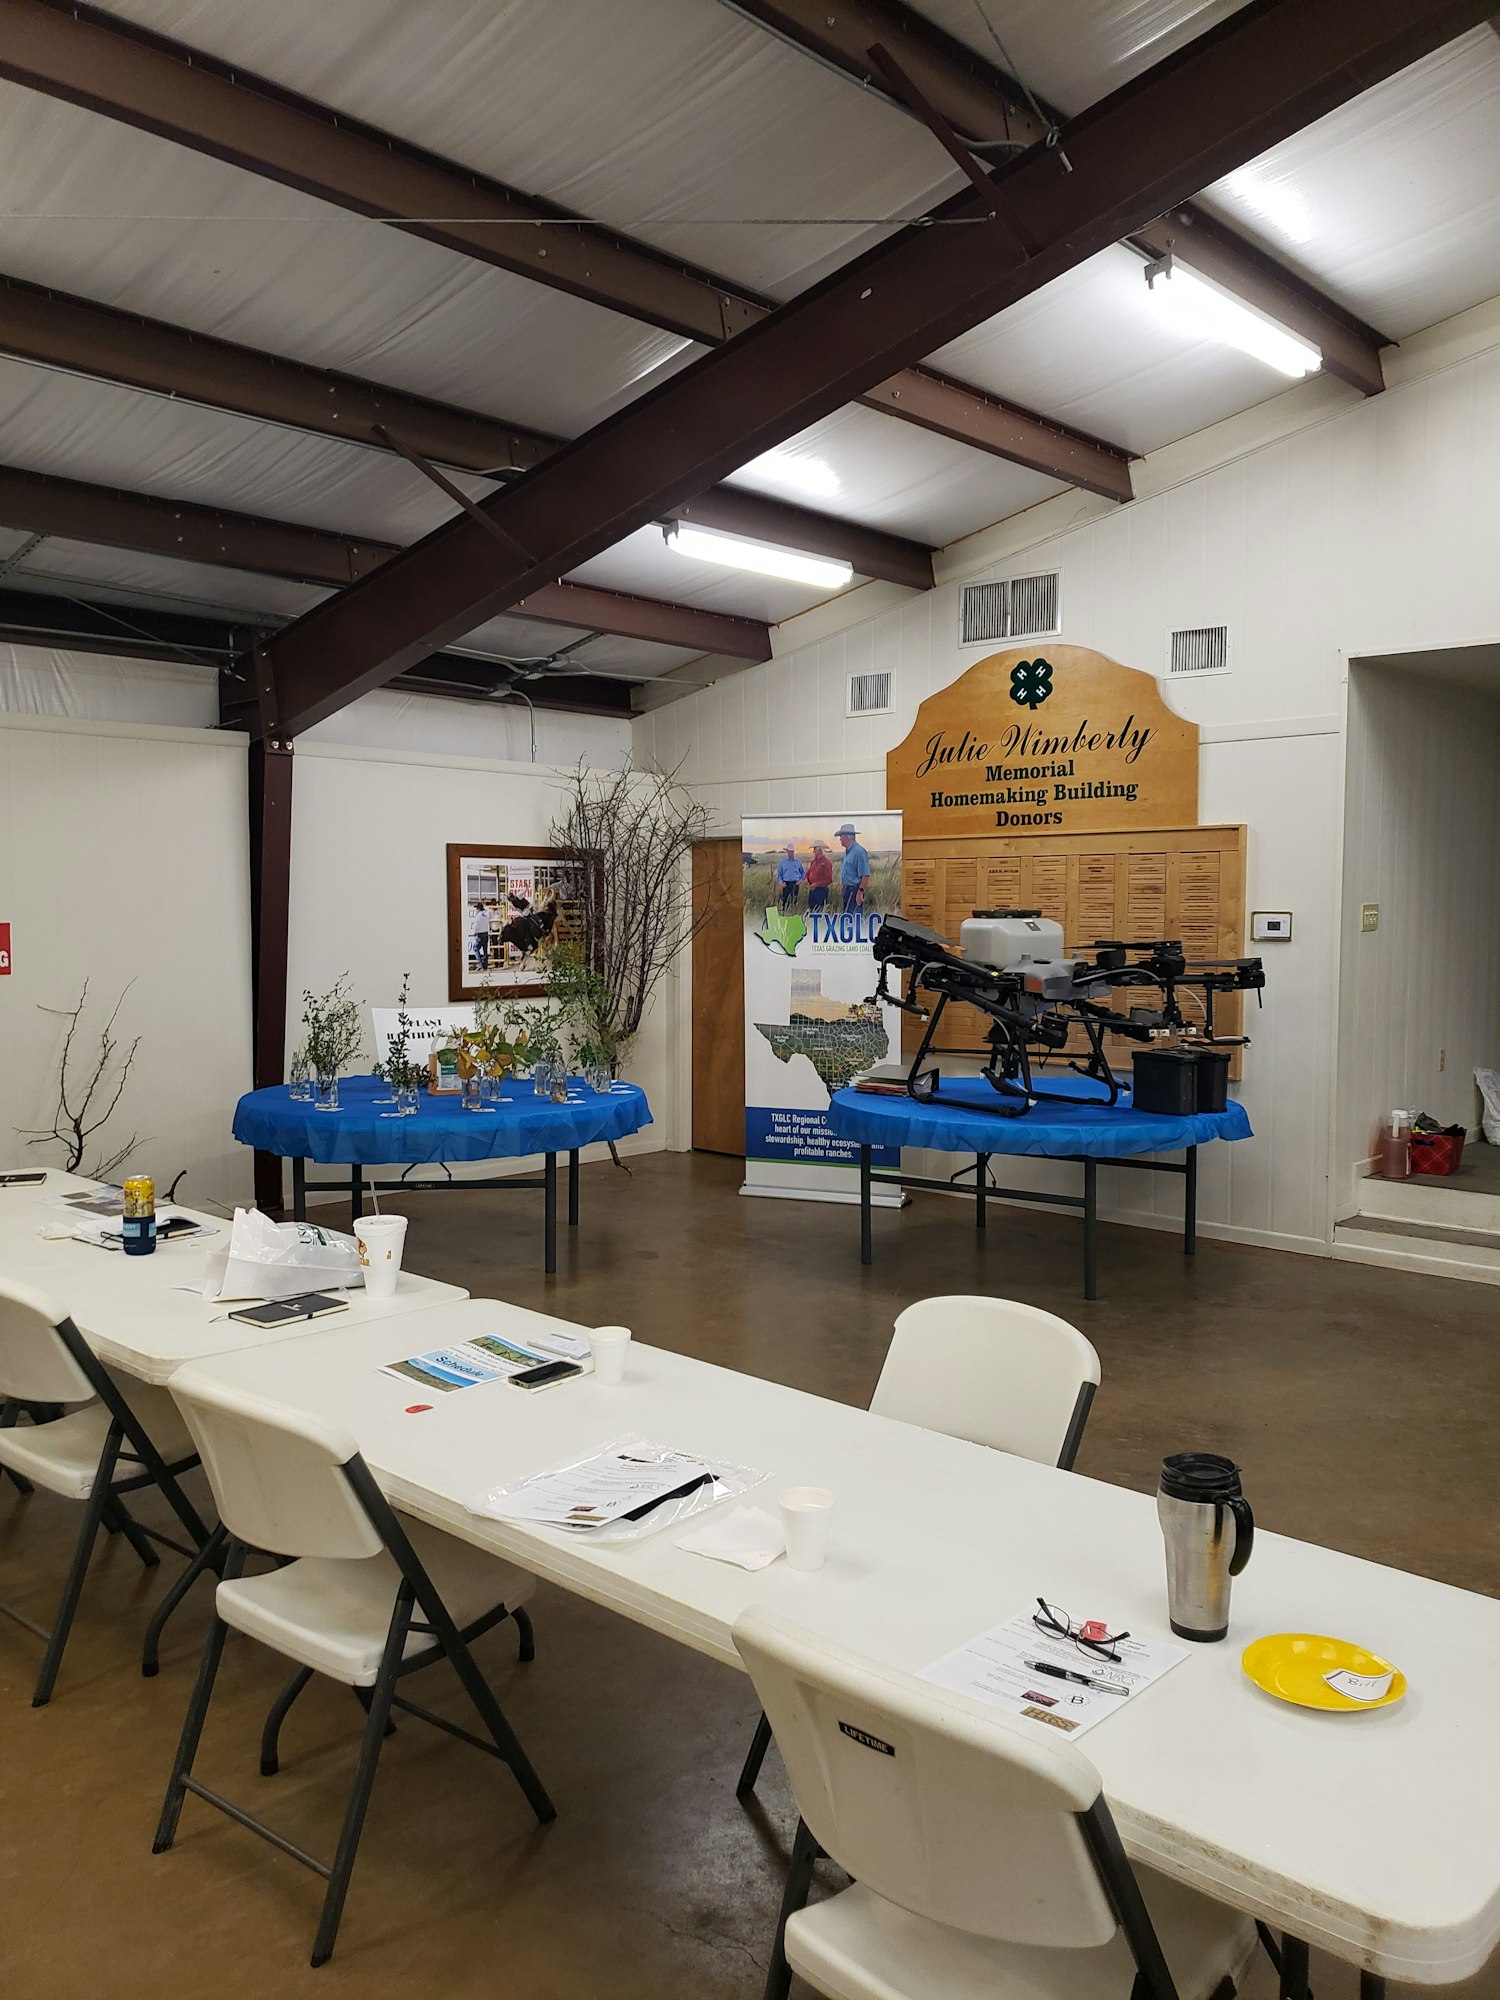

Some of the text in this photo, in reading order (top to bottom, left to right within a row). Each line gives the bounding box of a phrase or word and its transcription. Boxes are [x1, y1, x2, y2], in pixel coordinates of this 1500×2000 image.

[915, 714, 1158, 779] Julie Wimberly
[985, 759, 1075, 782] Memorial
[930, 780, 1139, 808] Homemaking Building
[995, 810, 1063, 827] Donors
[809, 912, 882, 944] TXGLC
[826, 945, 846, 953] GRAZING
[846, 945, 859, 953] LAND
[770, 1112, 791, 1123] TXGLC
[792, 1114, 820, 1126] Regional
[774, 1124, 792, 1134] heart
[792, 1125, 799, 1134] of
[800, 1127, 811, 1135] our
[806, 1136, 831, 1148] healthy
[793, 1146, 854, 1159] profitable ranches.
[435, 1356, 484, 1377] Schedule
[1105, 1671, 1135, 1686] NRCS
[1347, 1678, 1378, 1688] Bill
[843, 1725, 889, 1753] LIFETIME
